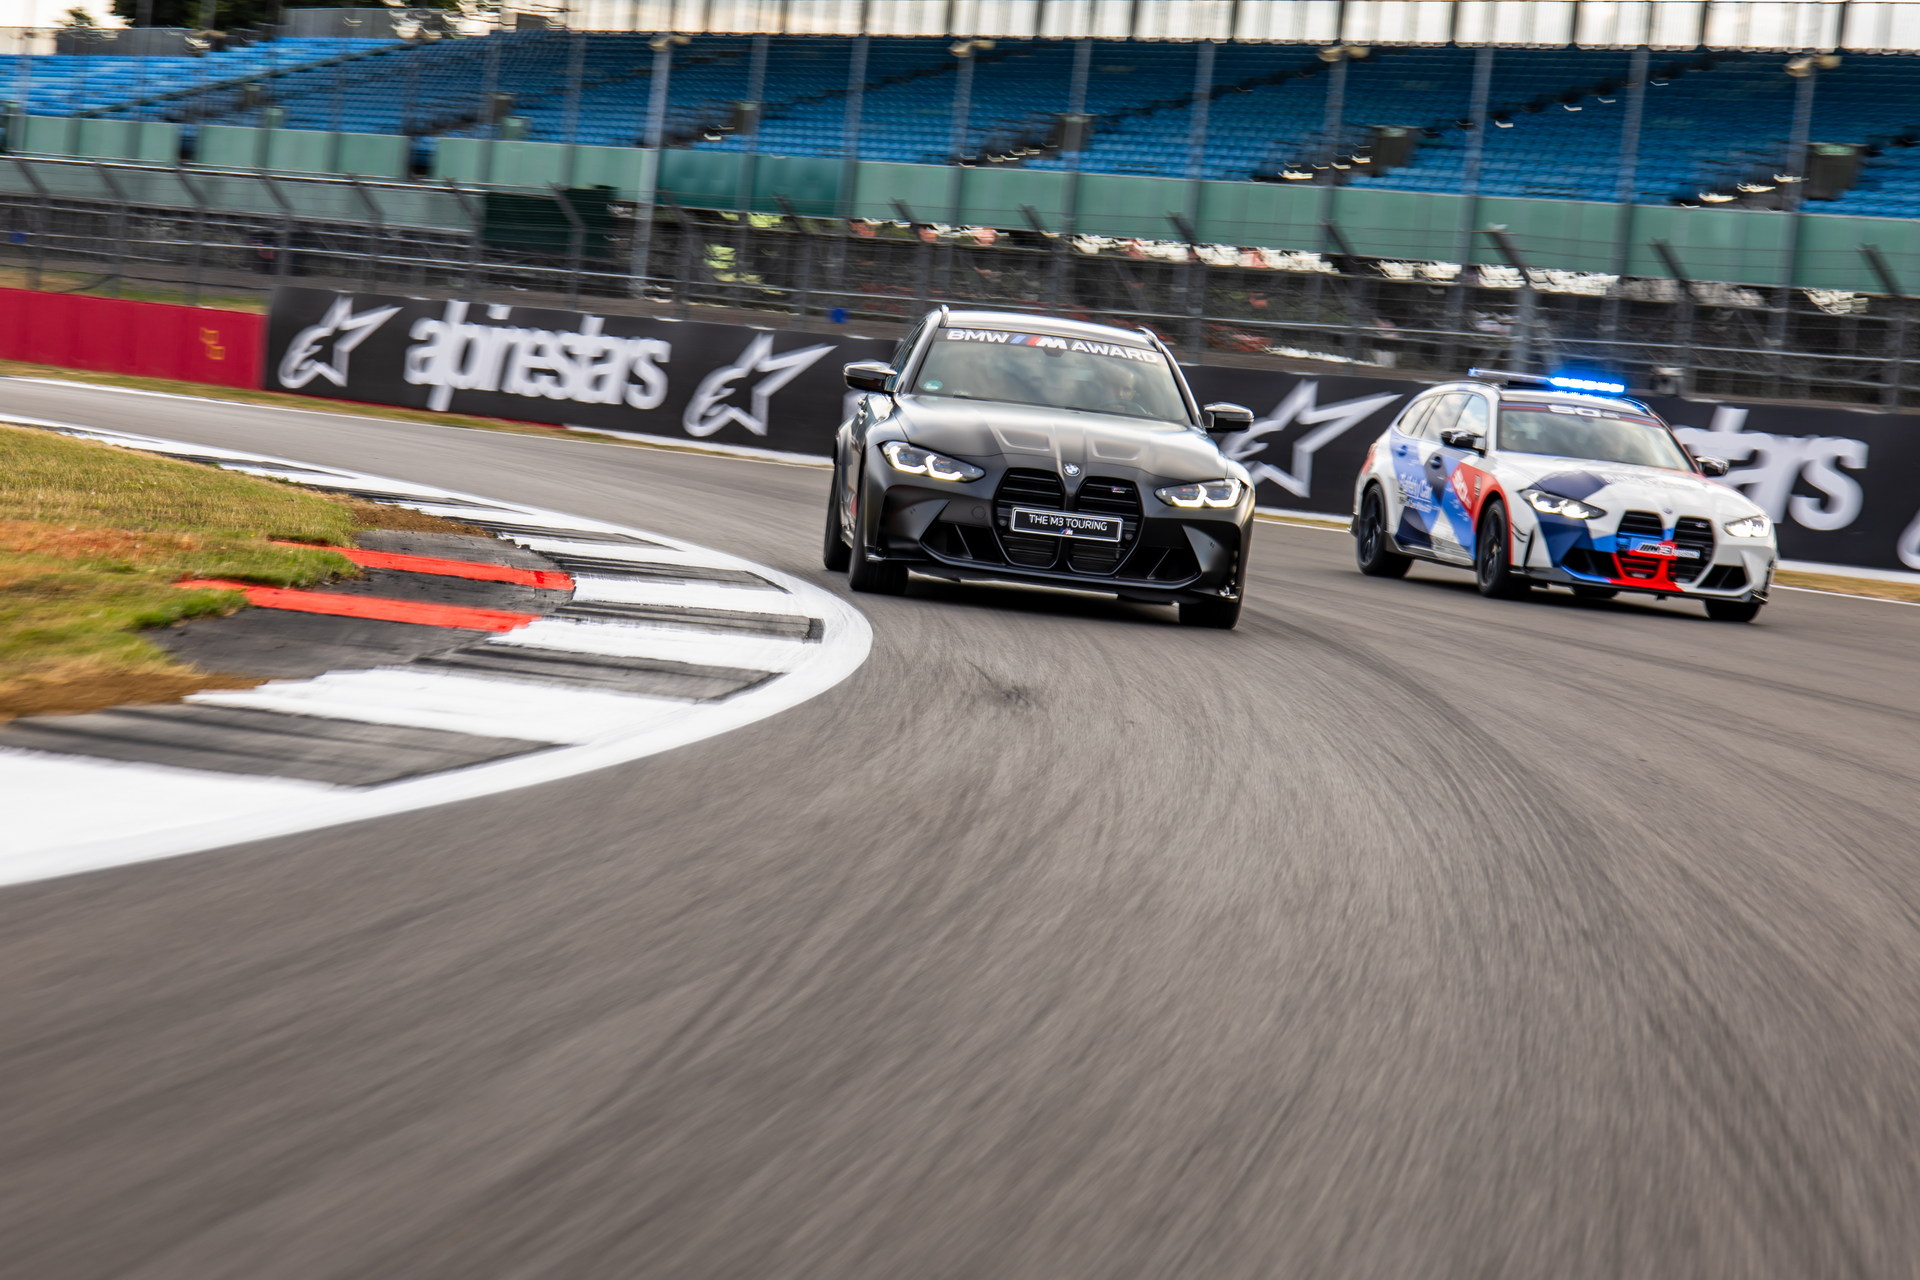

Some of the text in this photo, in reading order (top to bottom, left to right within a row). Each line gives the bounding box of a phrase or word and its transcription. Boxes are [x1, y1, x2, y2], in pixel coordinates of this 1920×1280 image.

[946, 329, 1009, 344] BMW
[1071, 341, 1159, 363] AWARD
[1029, 514, 1108, 531] THE M3 TOURING
